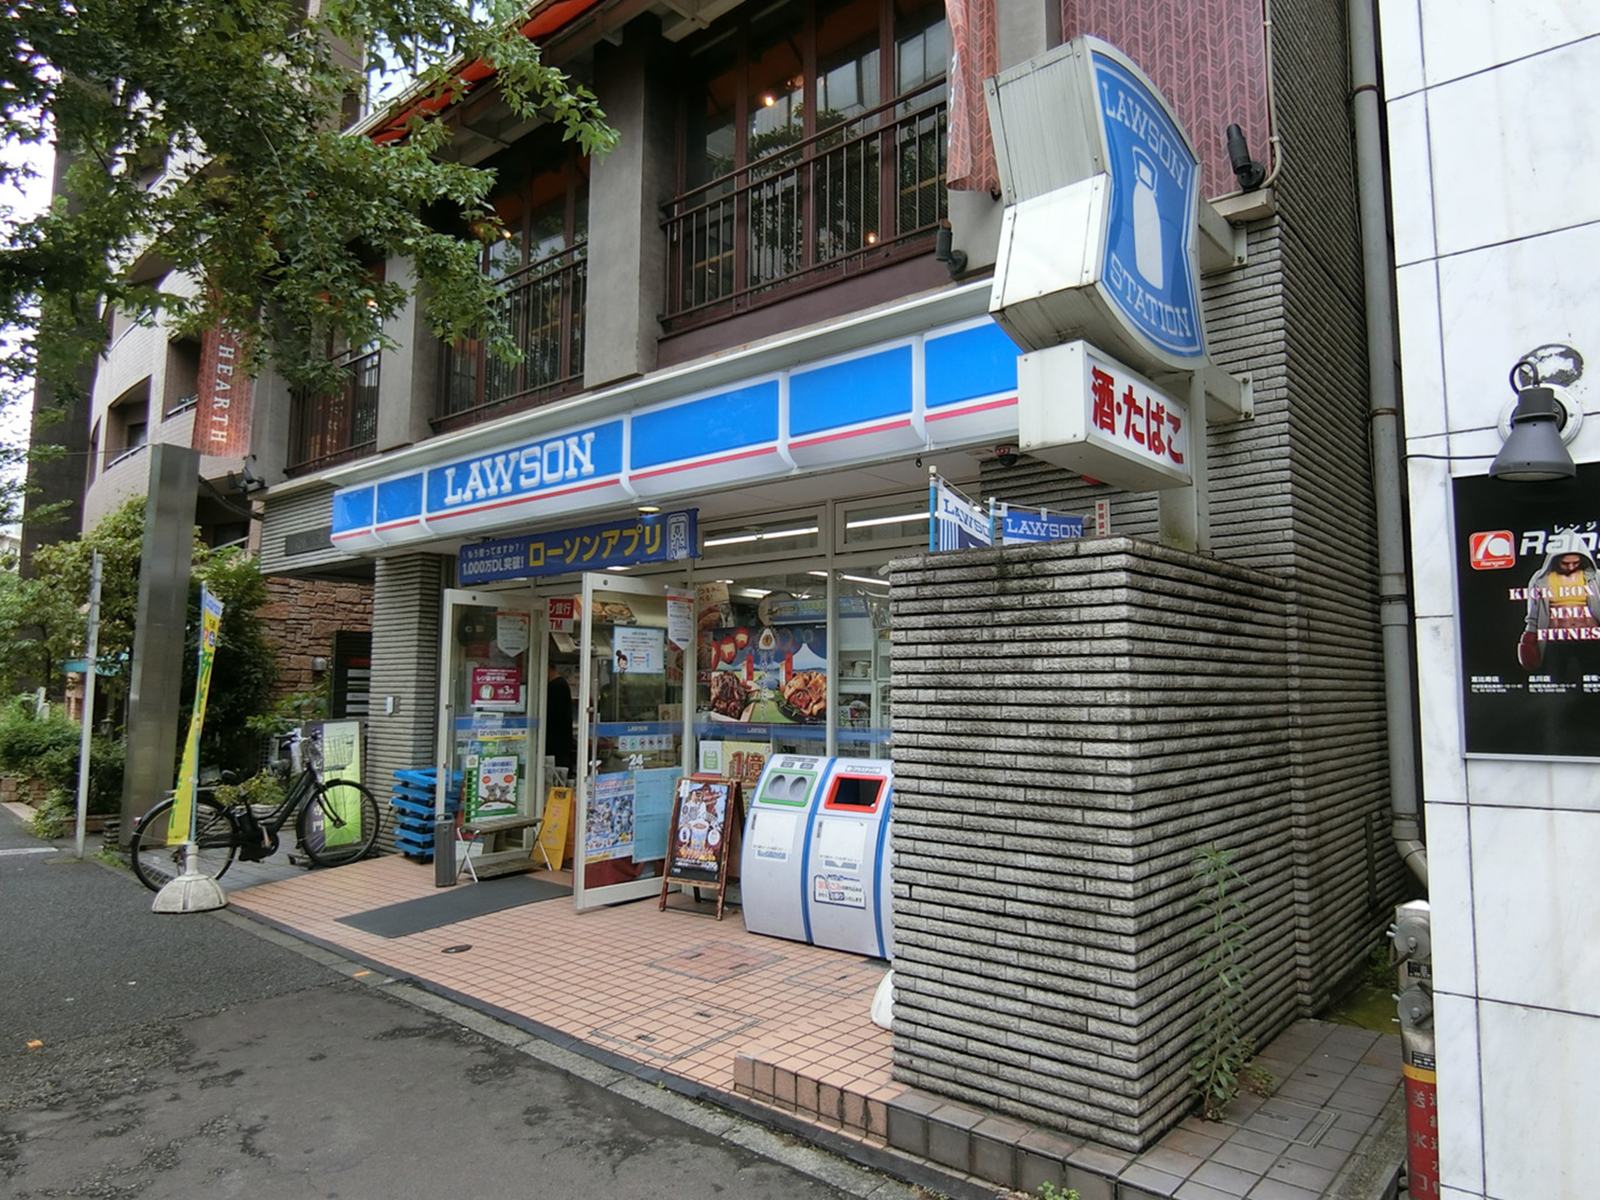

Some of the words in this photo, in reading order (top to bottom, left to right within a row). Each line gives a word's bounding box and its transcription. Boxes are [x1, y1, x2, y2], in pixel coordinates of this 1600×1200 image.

[1101, 81, 1185, 190] LAWSON
[1110, 252, 1192, 338] STATION
[210, 344, 235, 443] HEARTH
[1091, 365, 1184, 464] 酒・たばこ
[444, 432, 595, 506] LAWSON
[529, 523, 661, 567] ローソンアプリ
[1006, 518, 1083, 539] LAWSON
[1519, 531, 1600, 559] Ran
[1508, 587, 1554, 601] KICK
[1549, 606, 1593, 619] MMA
[629, 753, 644, 766] 24
